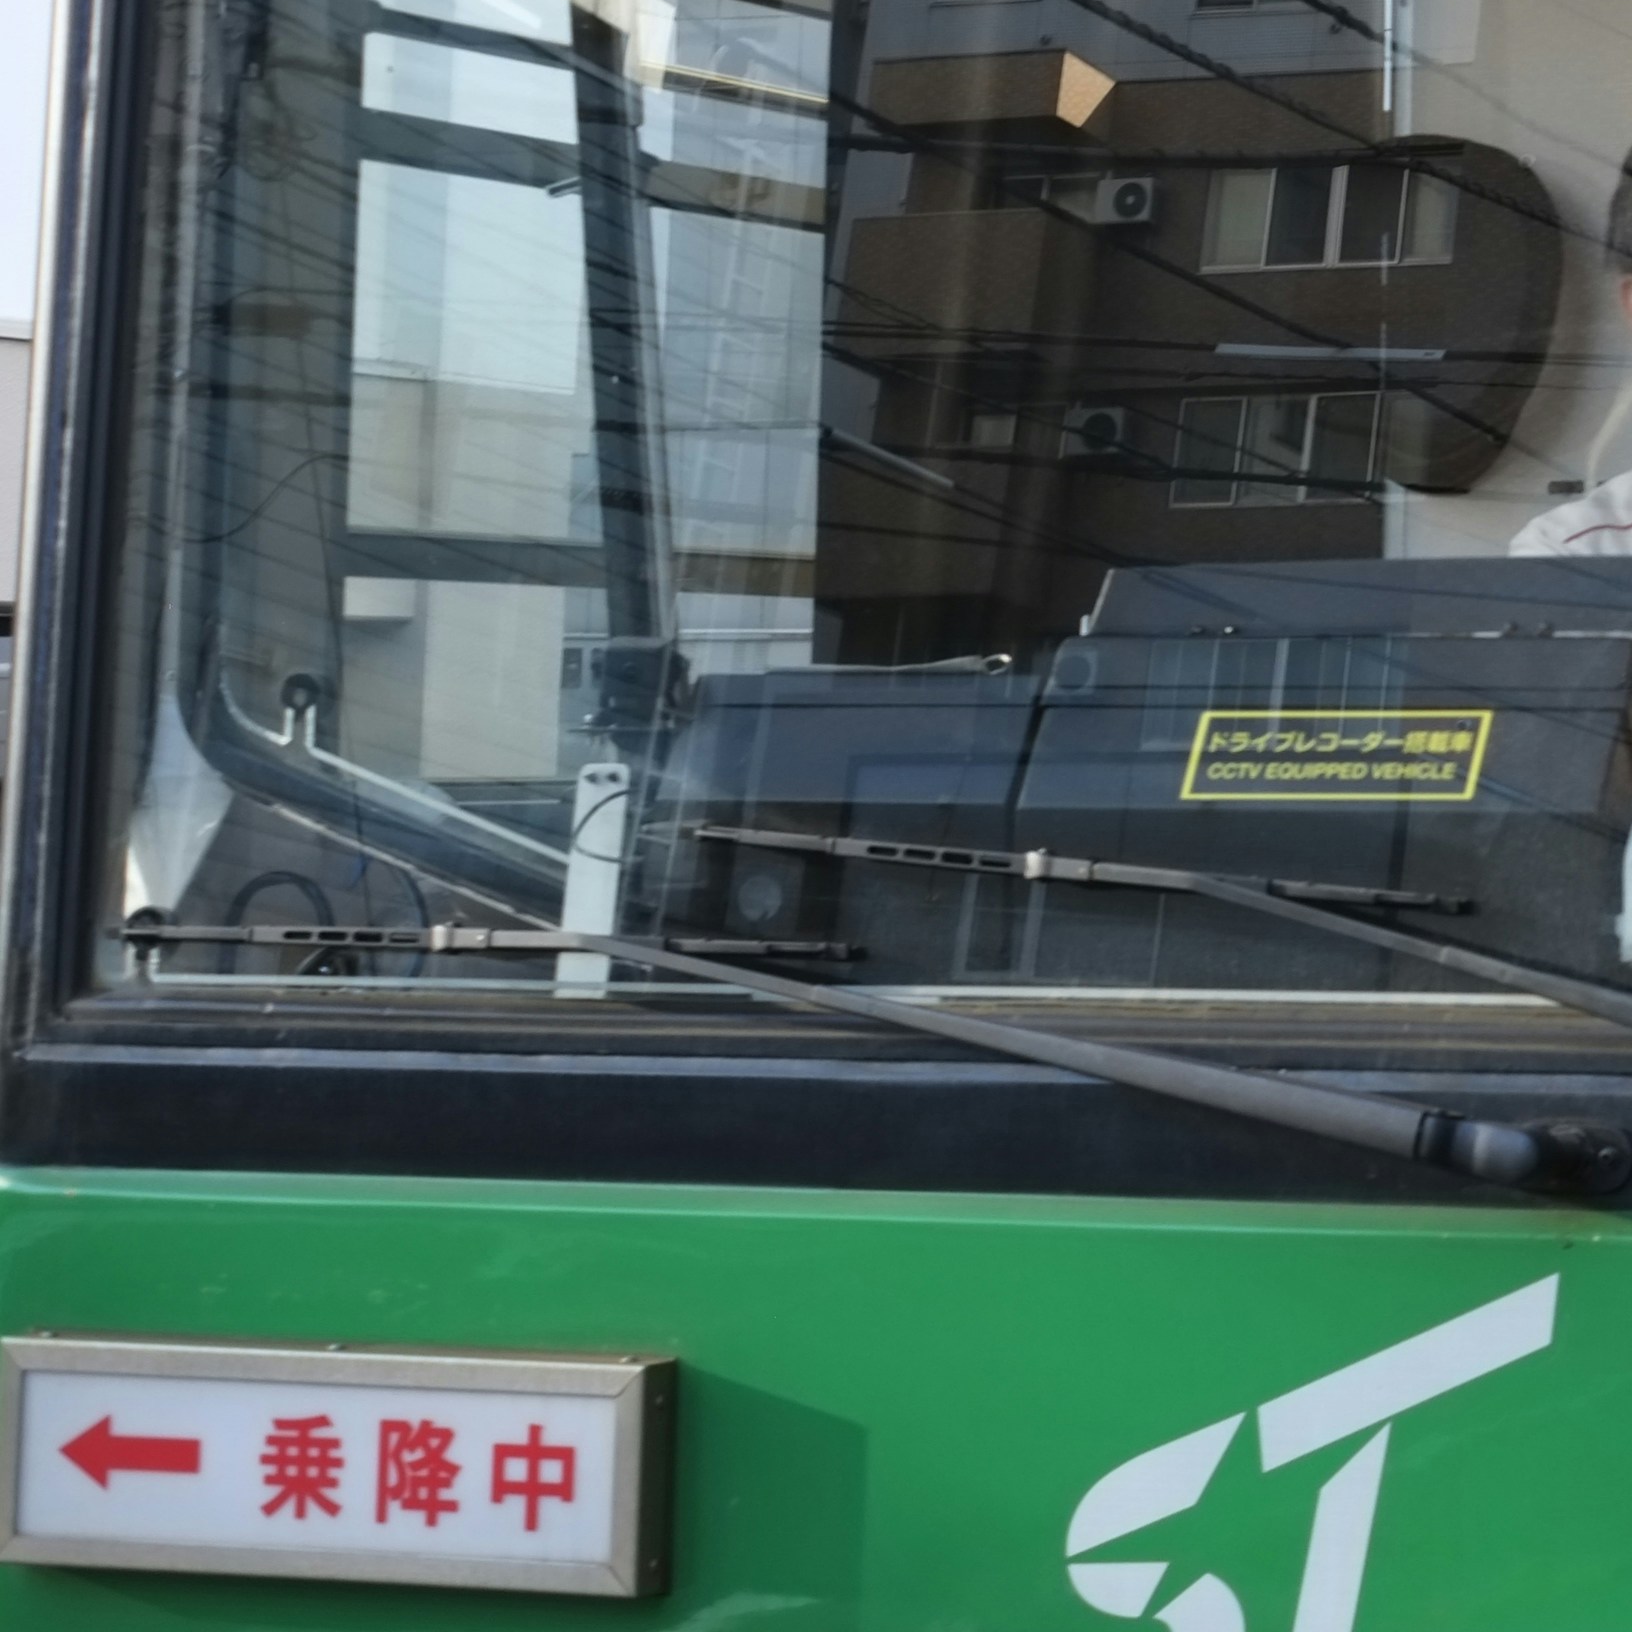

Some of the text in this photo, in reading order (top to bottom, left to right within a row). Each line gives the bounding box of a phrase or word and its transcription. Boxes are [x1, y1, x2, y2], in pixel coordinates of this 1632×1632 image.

[1207, 761, 1457, 781] CCTV EQUIPPED VEHICLE
[258, 1413, 579, 1534] 乗降中
